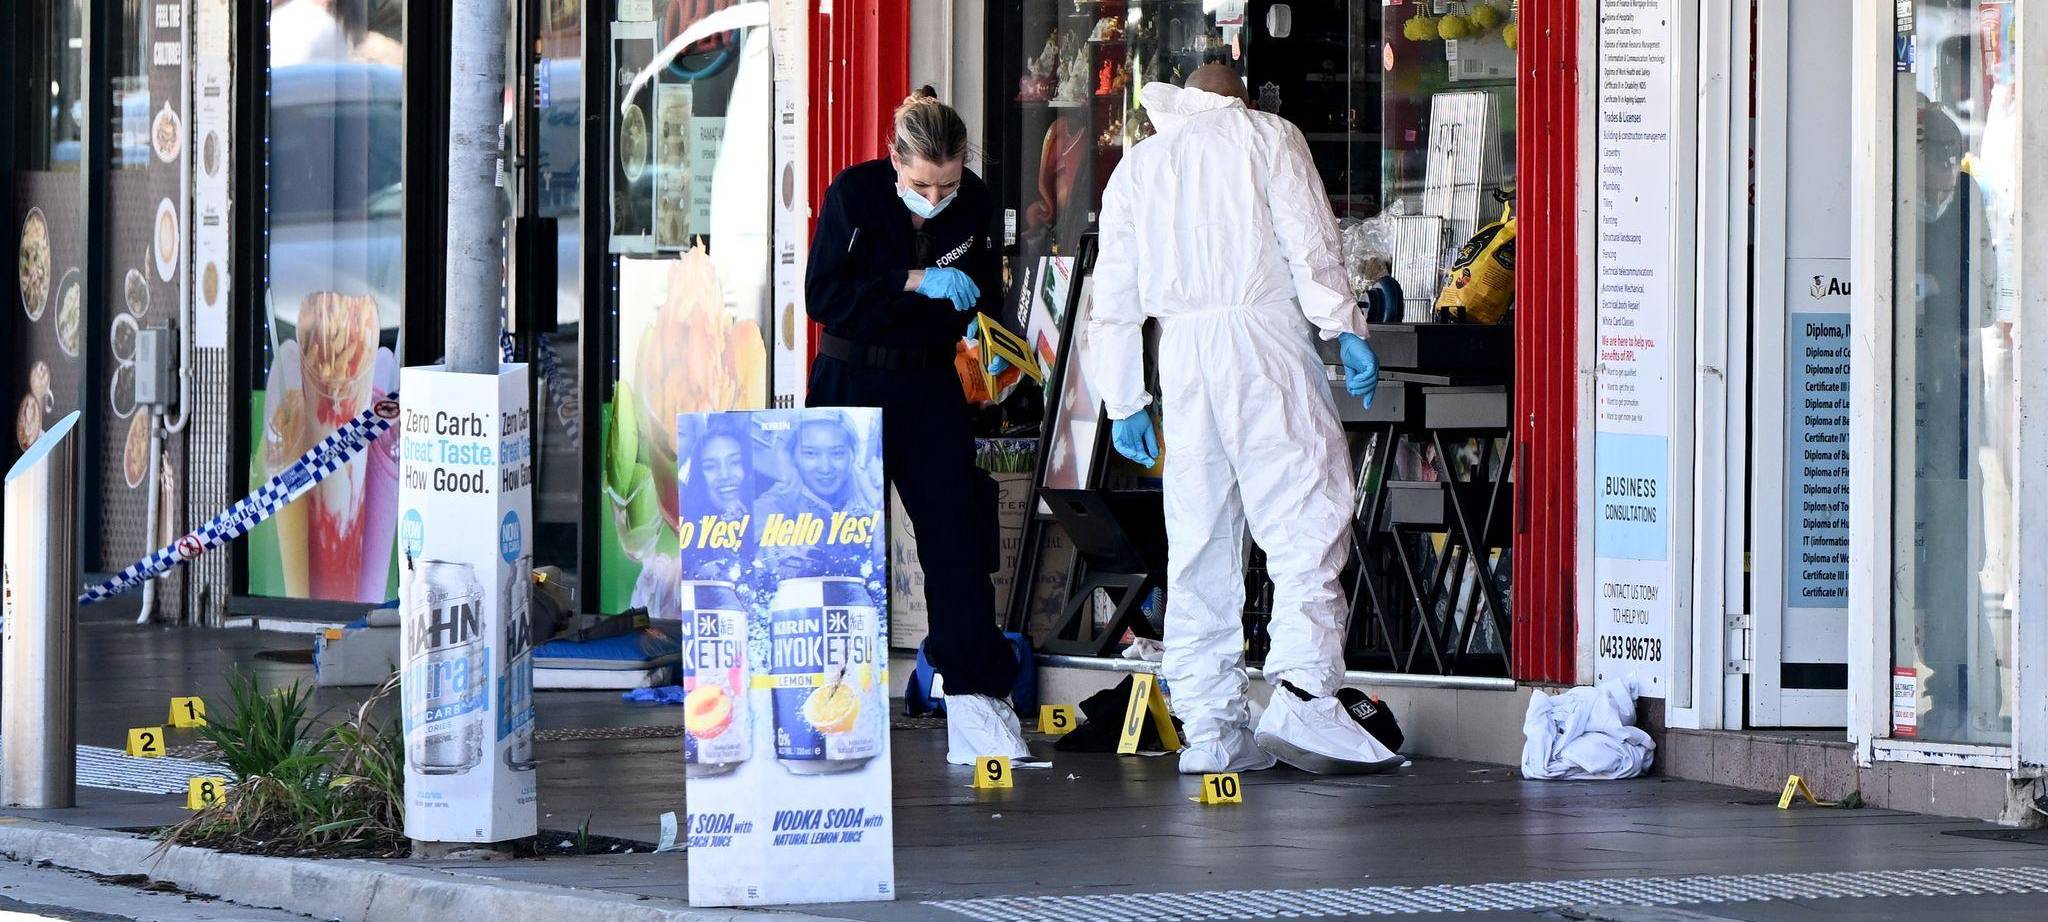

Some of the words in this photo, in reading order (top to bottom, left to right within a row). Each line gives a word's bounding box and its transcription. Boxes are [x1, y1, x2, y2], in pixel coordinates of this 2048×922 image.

[1604, 111, 1618, 123] Trades
[1828, 276, 1851, 295] Au
[1806, 323, 1844, 341] Diploma,
[1617, 335, 1628, 346] here
[1634, 335, 1645, 349] help
[1602, 349, 1620, 361] Benefits
[1806, 347, 1833, 360] Diploma
[1835, 347, 1842, 358] of
[1805, 364, 1833, 377] Diploma
[1835, 364, 1842, 375] of
[1805, 380, 1839, 392] Certificate
[1805, 398, 1833, 410] Diploma
[1834, 398, 1841, 409] of
[406, 408, 429, 434] Zero
[502, 411, 517, 437] Zero
[1805, 415, 1832, 427] Diploma
[1834, 415, 1841, 426] of
[1804, 432, 1838, 443] Certificate
[404, 436, 433, 463] Great
[438, 439, 497, 466] Taste.
[1804, 449, 1832, 462] Diploma
[1833, 449, 1841, 460] of
[405, 463, 428, 491] How
[433, 467, 490, 494] Good.
[1804, 466, 1831, 479] Diploma
[1833, 466, 1840, 477] of
[1606, 476, 1656, 498] BUSINESS
[1803, 484, 1831, 497] Diploma
[1832, 484, 1840, 494] of
[1605, 503, 1657, 523] CONSULTATIONS
[1832, 501, 1840, 511] of
[502, 522, 520, 542] NOW
[697, 515, 750, 550] Yes!
[759, 512, 825, 548] Hello
[827, 510, 881, 545] Yes!
[1803, 518, 1831, 531] Diploma
[1832, 518, 1840, 529] of
[1803, 535, 1809, 546] IT
[1802, 552, 1830, 565] Diploma
[1832, 552, 1839, 563] of
[1802, 569, 1836, 580] Certificate
[1604, 583, 1630, 599] CONTACT
[1631, 584, 1638, 599] US
[1639, 585, 1658, 601] TODAY
[1802, 586, 1836, 598] Certificate
[1613, 608, 1620, 623] TO
[1622, 609, 1636, 624] HELP
[1636, 609, 1649, 625] YOU
[774, 618, 820, 635] KIRIN
[1600, 634, 1622, 659] 0433
[1626, 636, 1662, 662] 986738
[779, 675, 813, 687] LEMON
[184, 700, 196, 720] 1
[427, 706, 462, 721] CARB
[1052, 708, 1067, 727] 5
[140, 732, 155, 752] 2
[986, 759, 1002, 781] 9
[200, 781, 215, 803] 8
[1210, 776, 1238, 798] 10
[696, 813, 735, 834] SODA
[734, 821, 753, 834] with
[772, 809, 823, 832] VODKA
[824, 807, 865, 829] SODA
[864, 814, 884, 828] with
[710, 835, 733, 848] JUICE
[773, 832, 810, 847] NATURAL
[811, 831, 839, 845] LEMON
[839, 830, 864, 844] JUICE
